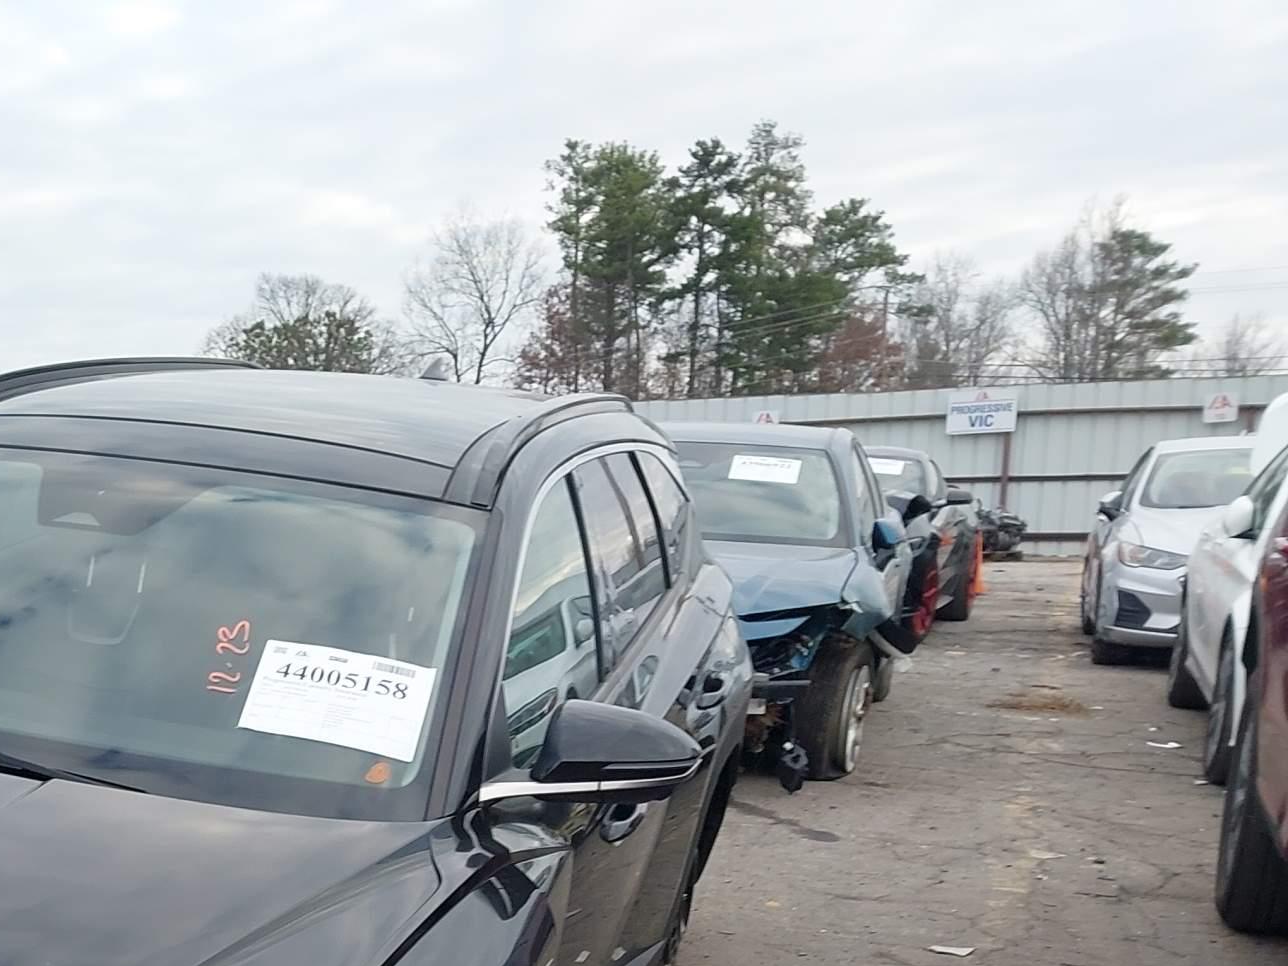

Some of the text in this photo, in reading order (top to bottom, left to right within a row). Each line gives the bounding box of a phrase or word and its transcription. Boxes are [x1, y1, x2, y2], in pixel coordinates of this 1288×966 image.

[952, 403, 1013, 414] PROGRESSIVE
[968, 415, 994, 427] VIC
[276, 663, 409, 700] 44005158
